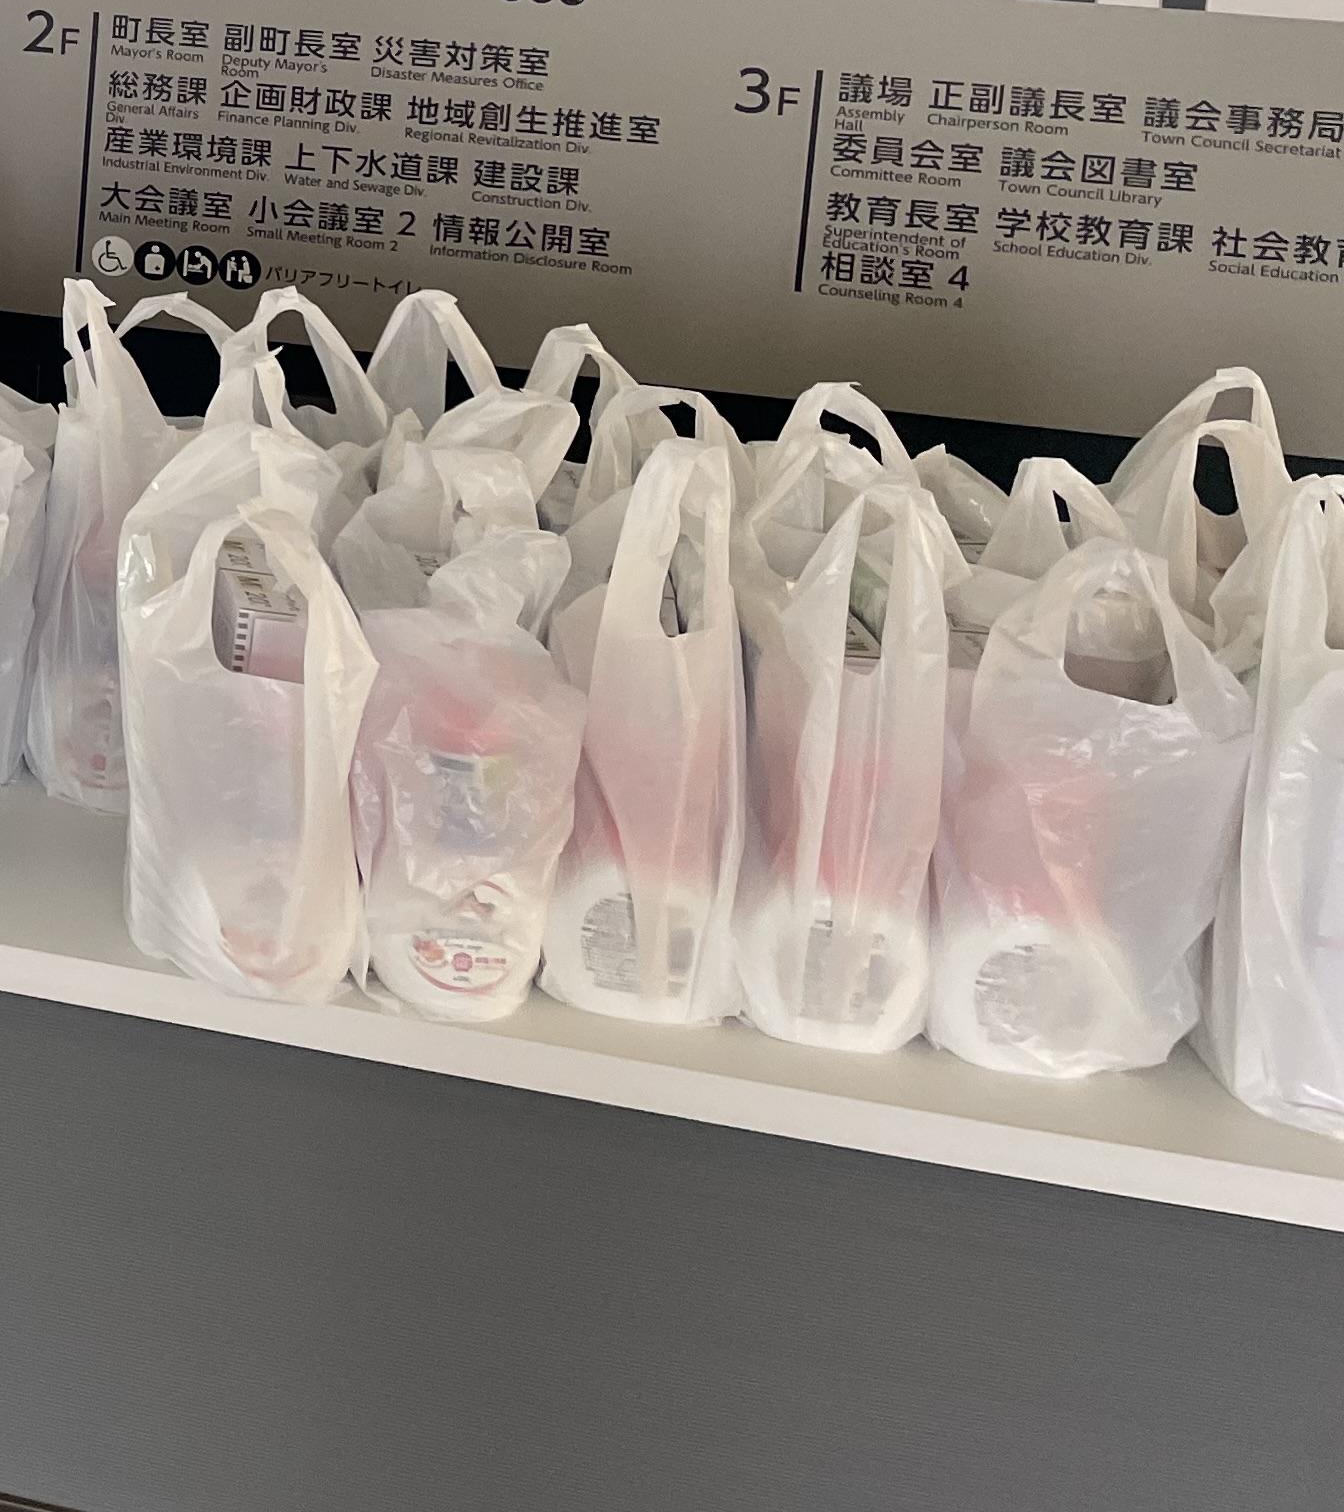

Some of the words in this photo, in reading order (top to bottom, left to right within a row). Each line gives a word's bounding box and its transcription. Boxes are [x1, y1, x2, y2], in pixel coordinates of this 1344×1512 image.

[22, 8, 80, 57] 2F
[112, 14, 210, 48] 町長室
[224, 22, 361, 61] 副町長室
[372, 35, 550, 77] 災害対策室
[111, 45, 162, 60] Mayor's
[167, 49, 204, 63] Room
[371, 66, 428, 83] Disaster
[431, 72, 498, 88] Measures
[503, 77, 544, 92] Office
[734, 66, 802, 116] 3F
[108, 70, 208, 105] 総務課
[220, 79, 392, 121] 企画財政課
[407, 95, 660, 145] 地域創生推進室
[838, 71, 913, 108] 議場
[928, 79, 1128, 125] 正副議長室
[1143, 96, 1343, 143] 議会事務局
[926, 113, 1020, 134] Chairperson
[1024, 120, 1070, 137] Room
[103, 126, 272, 167] 産業環境課
[284, 142, 459, 185] 上下水道課
[473, 159, 580, 196] 建設課
[1141, 131, 1186, 146] Town
[1190, 135, 1250, 153] Council
[1255, 139, 1342, 161] Secretariat
[830, 165, 913, 184] Committee
[918, 171, 962, 188] Room
[832, 132, 984, 174] 委員会室
[999, 146, 1199, 193] 議会図書室
[471, 191, 561, 210] Construction
[565, 200, 593, 213] Div.
[998, 180, 1042, 195] Town
[1047, 184, 1105, 201] Council
[1109, 190, 1162, 208] Library
[100, 181, 233, 220] 大会議室
[247, 195, 384, 235] 小会議室
[397, 211, 416, 236] 2
[433, 212, 611, 257] 情報公開室
[825, 191, 980, 235] 教育長室
[995, 207, 1194, 254] 学校教育課
[1212, 225, 1343, 269] 社会教
[429, 245, 509, 264] Information
[513, 253, 587, 271] Disclosure
[591, 261, 633, 275] Room
[993, 241, 1043, 257] School
[1047, 245, 1120, 264] Education
[265, 266, 422, 295] バリアフリートイレ
[820, 251, 934, 291] 相談室
[948, 265, 970, 291] 4
[1209, 260, 1256, 277] Social
[1260, 266, 1339, 283] Education
